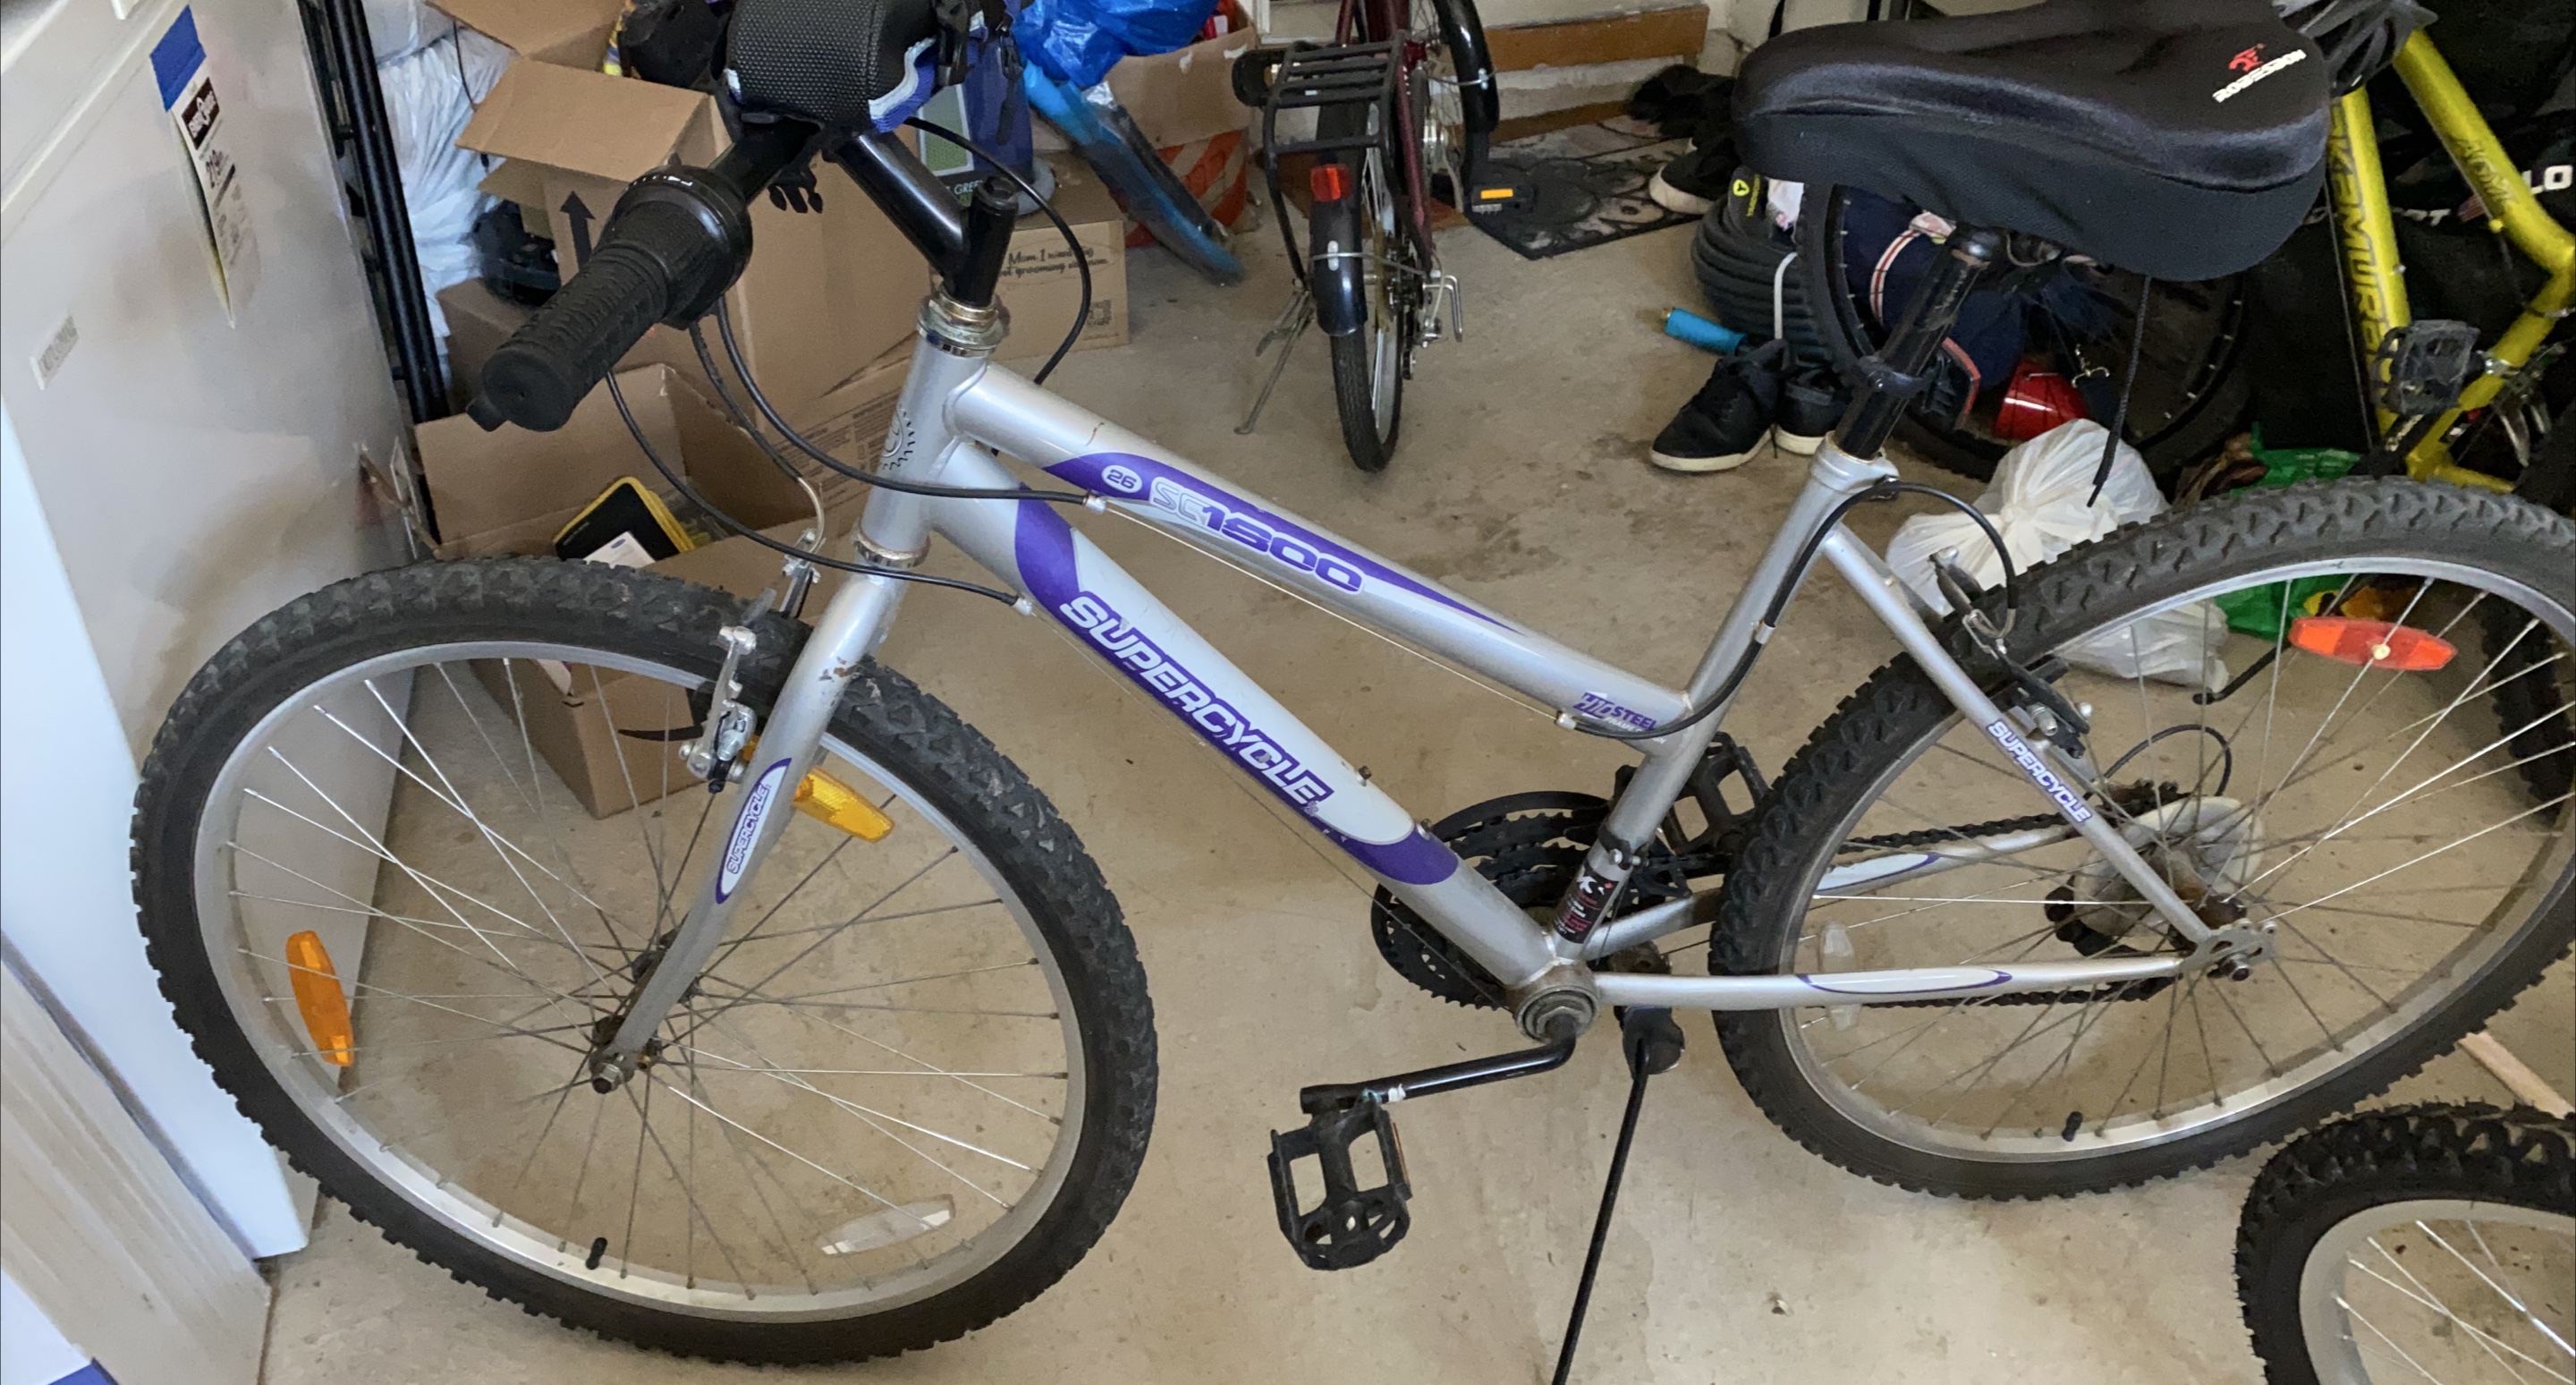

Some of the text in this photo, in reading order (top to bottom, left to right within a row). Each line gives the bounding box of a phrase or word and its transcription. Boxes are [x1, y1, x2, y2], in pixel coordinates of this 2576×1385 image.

[1106, 469, 1136, 489] 26
[1059, 594, 1329, 806] SUPERCYCLE
[1987, 719, 2092, 823] SUPERCYCLE
[726, 784, 770, 874] SUPERCYCLE
